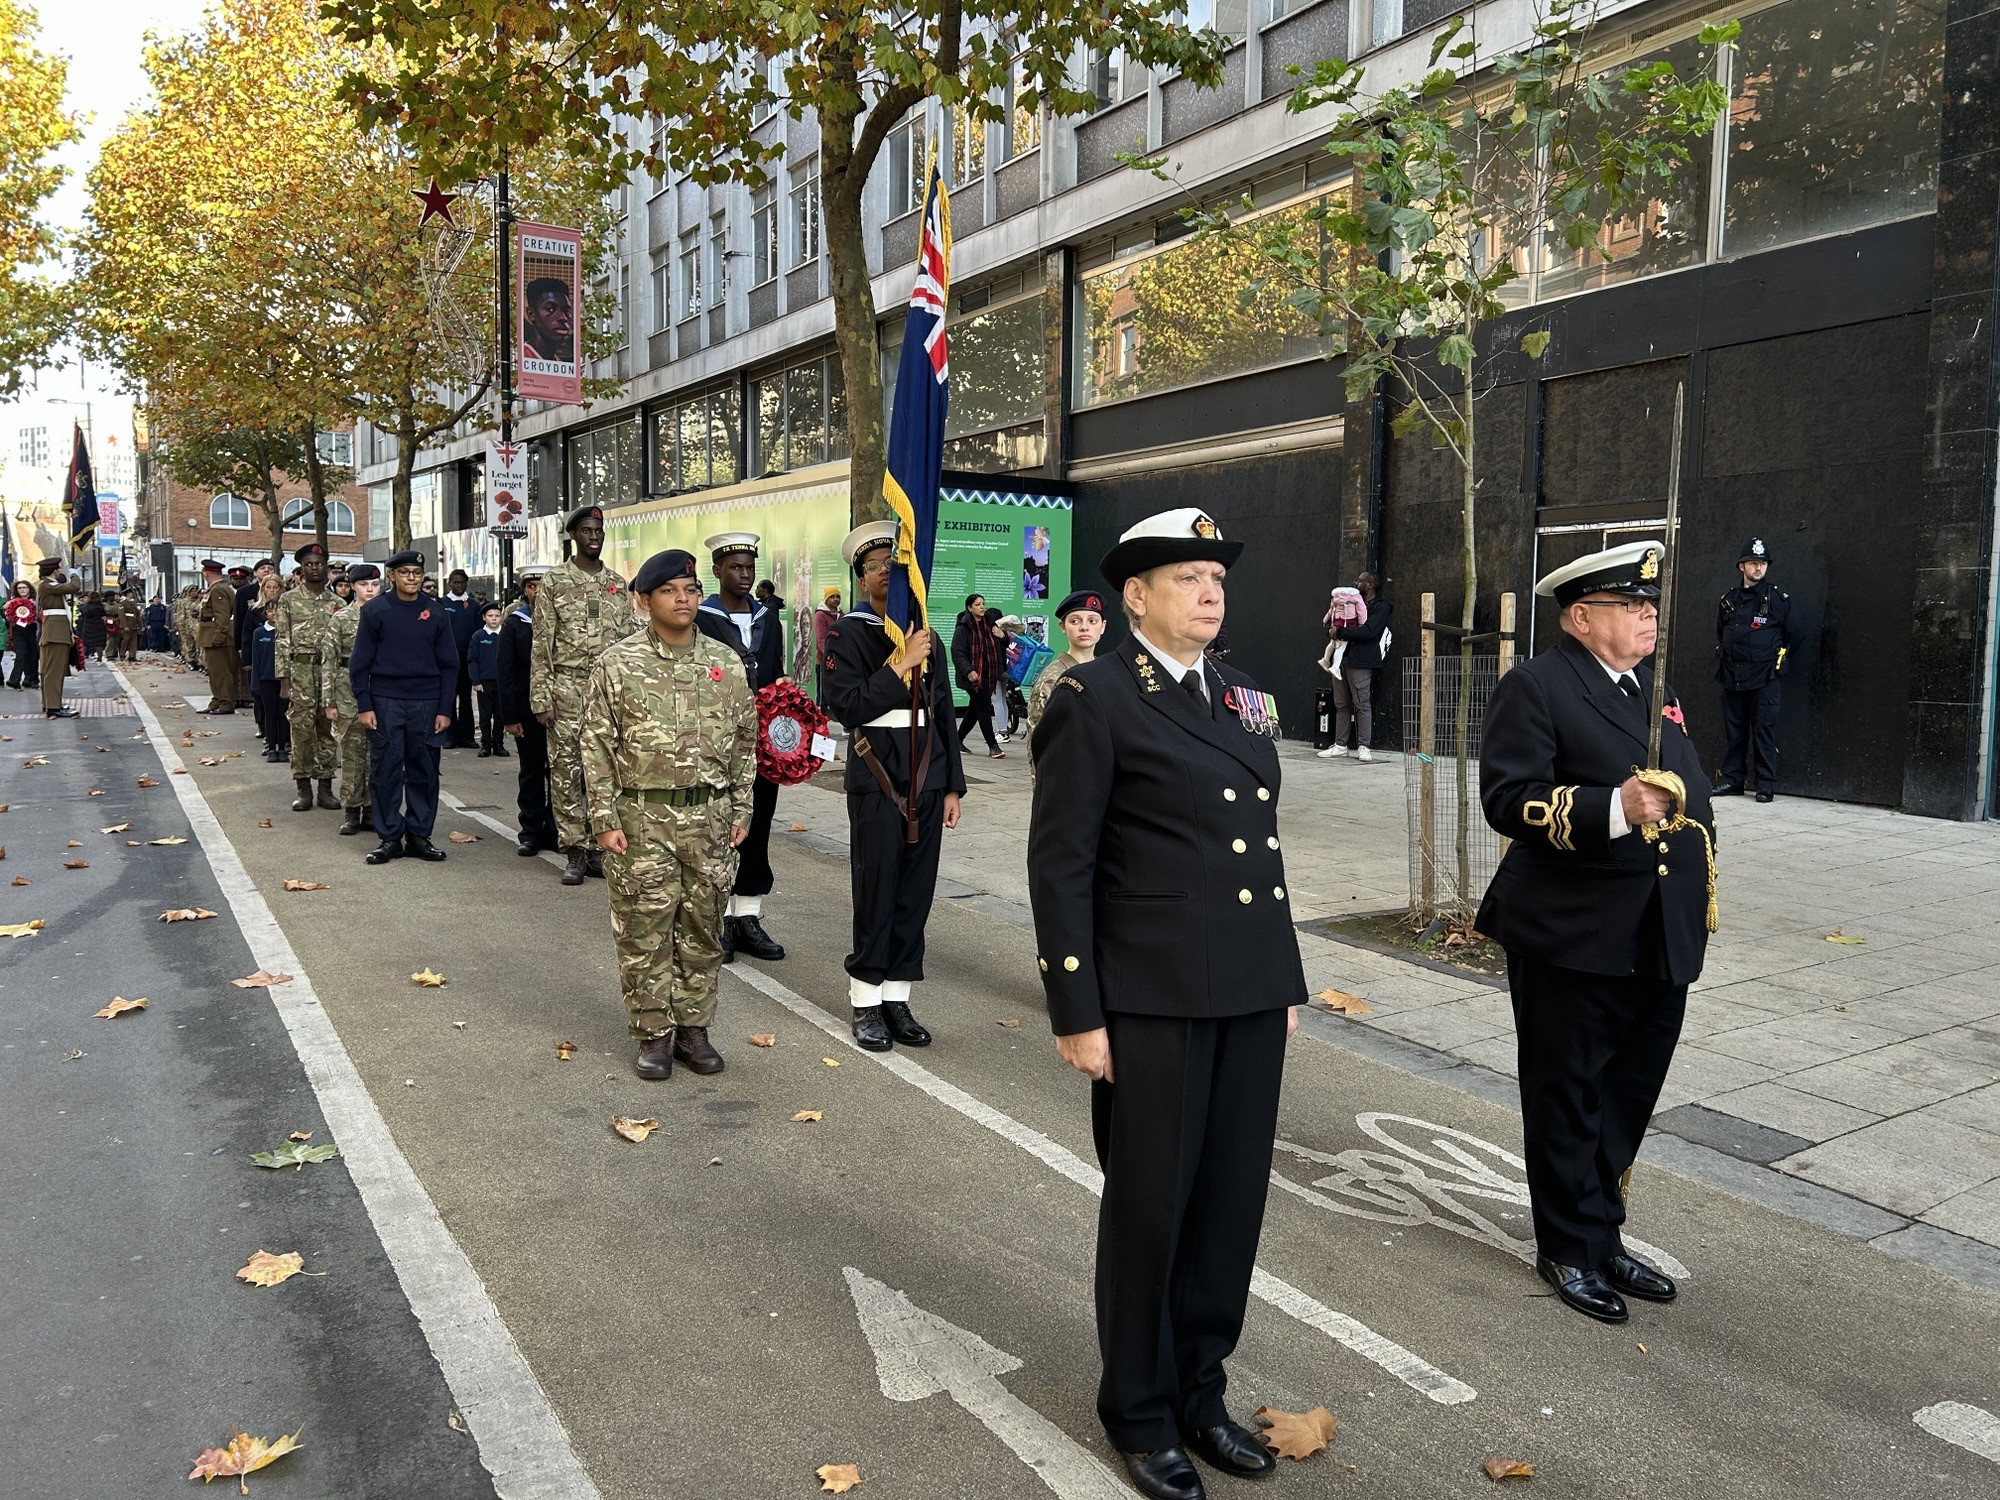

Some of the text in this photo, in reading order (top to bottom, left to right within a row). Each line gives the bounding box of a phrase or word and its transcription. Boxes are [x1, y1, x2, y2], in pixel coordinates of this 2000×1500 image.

[523, 237, 575, 255] CREATIVE
[523, 360, 575, 375] CROYDON
[491, 470, 510, 479] Lest
[494, 480, 522, 490] Forget
[944, 521, 1011, 533] EXHIBITION
